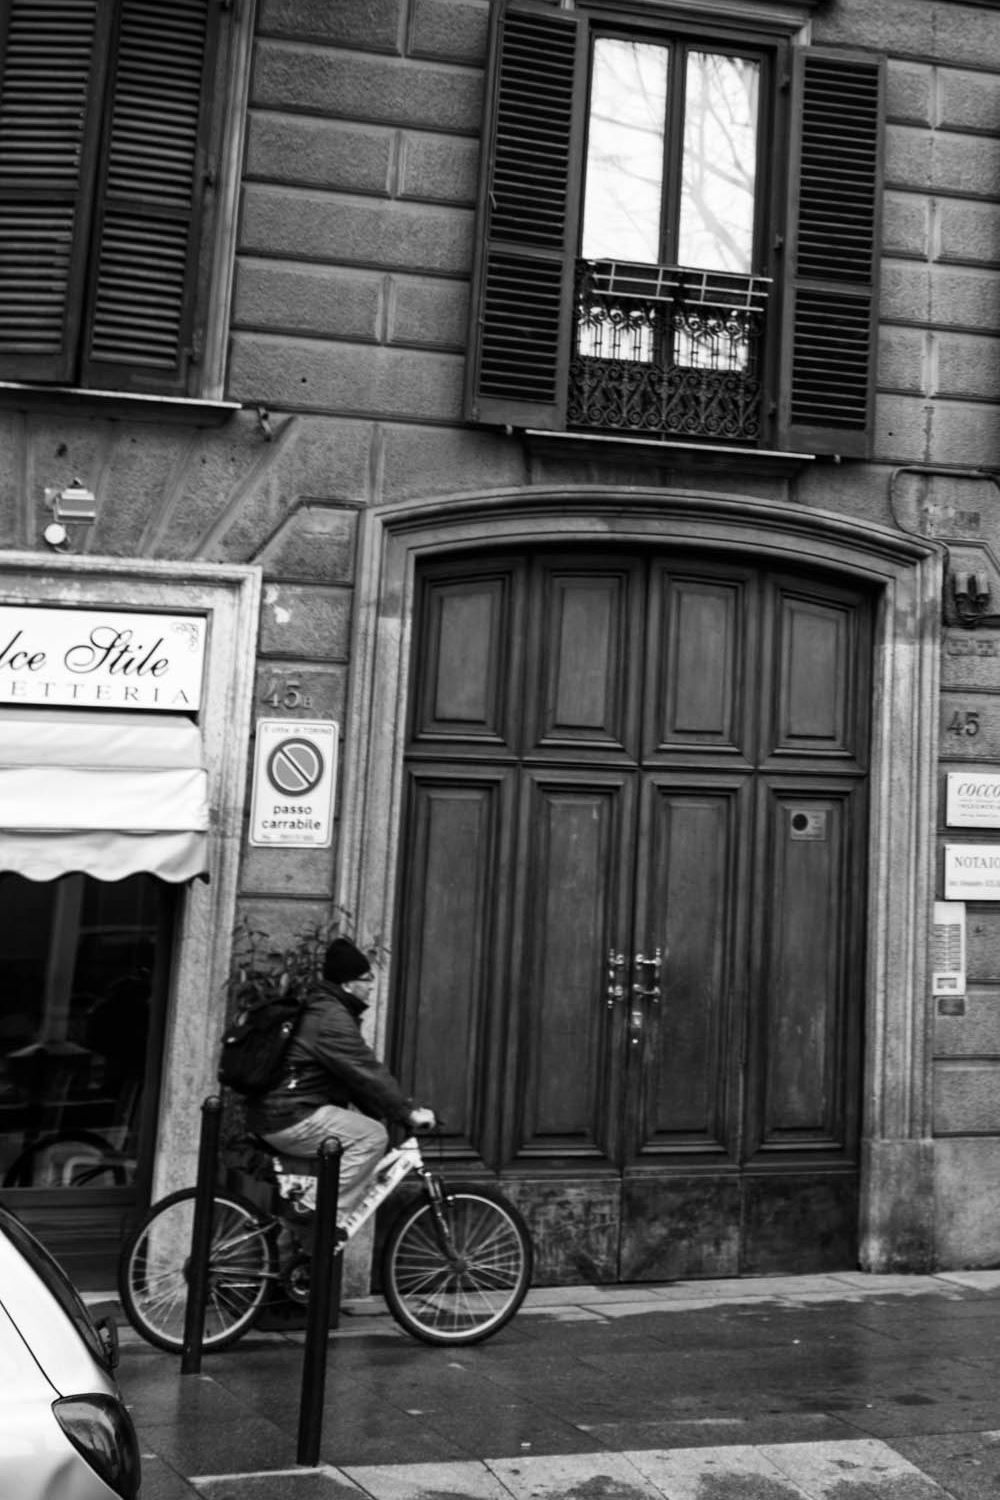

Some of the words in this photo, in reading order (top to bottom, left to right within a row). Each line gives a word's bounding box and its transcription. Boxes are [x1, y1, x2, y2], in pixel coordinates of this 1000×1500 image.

[64, 626, 169, 677] Stile
[947, 711, 979, 736] 45
[273, 805, 312, 815] passo
[262, 819, 321, 830] carrabile
